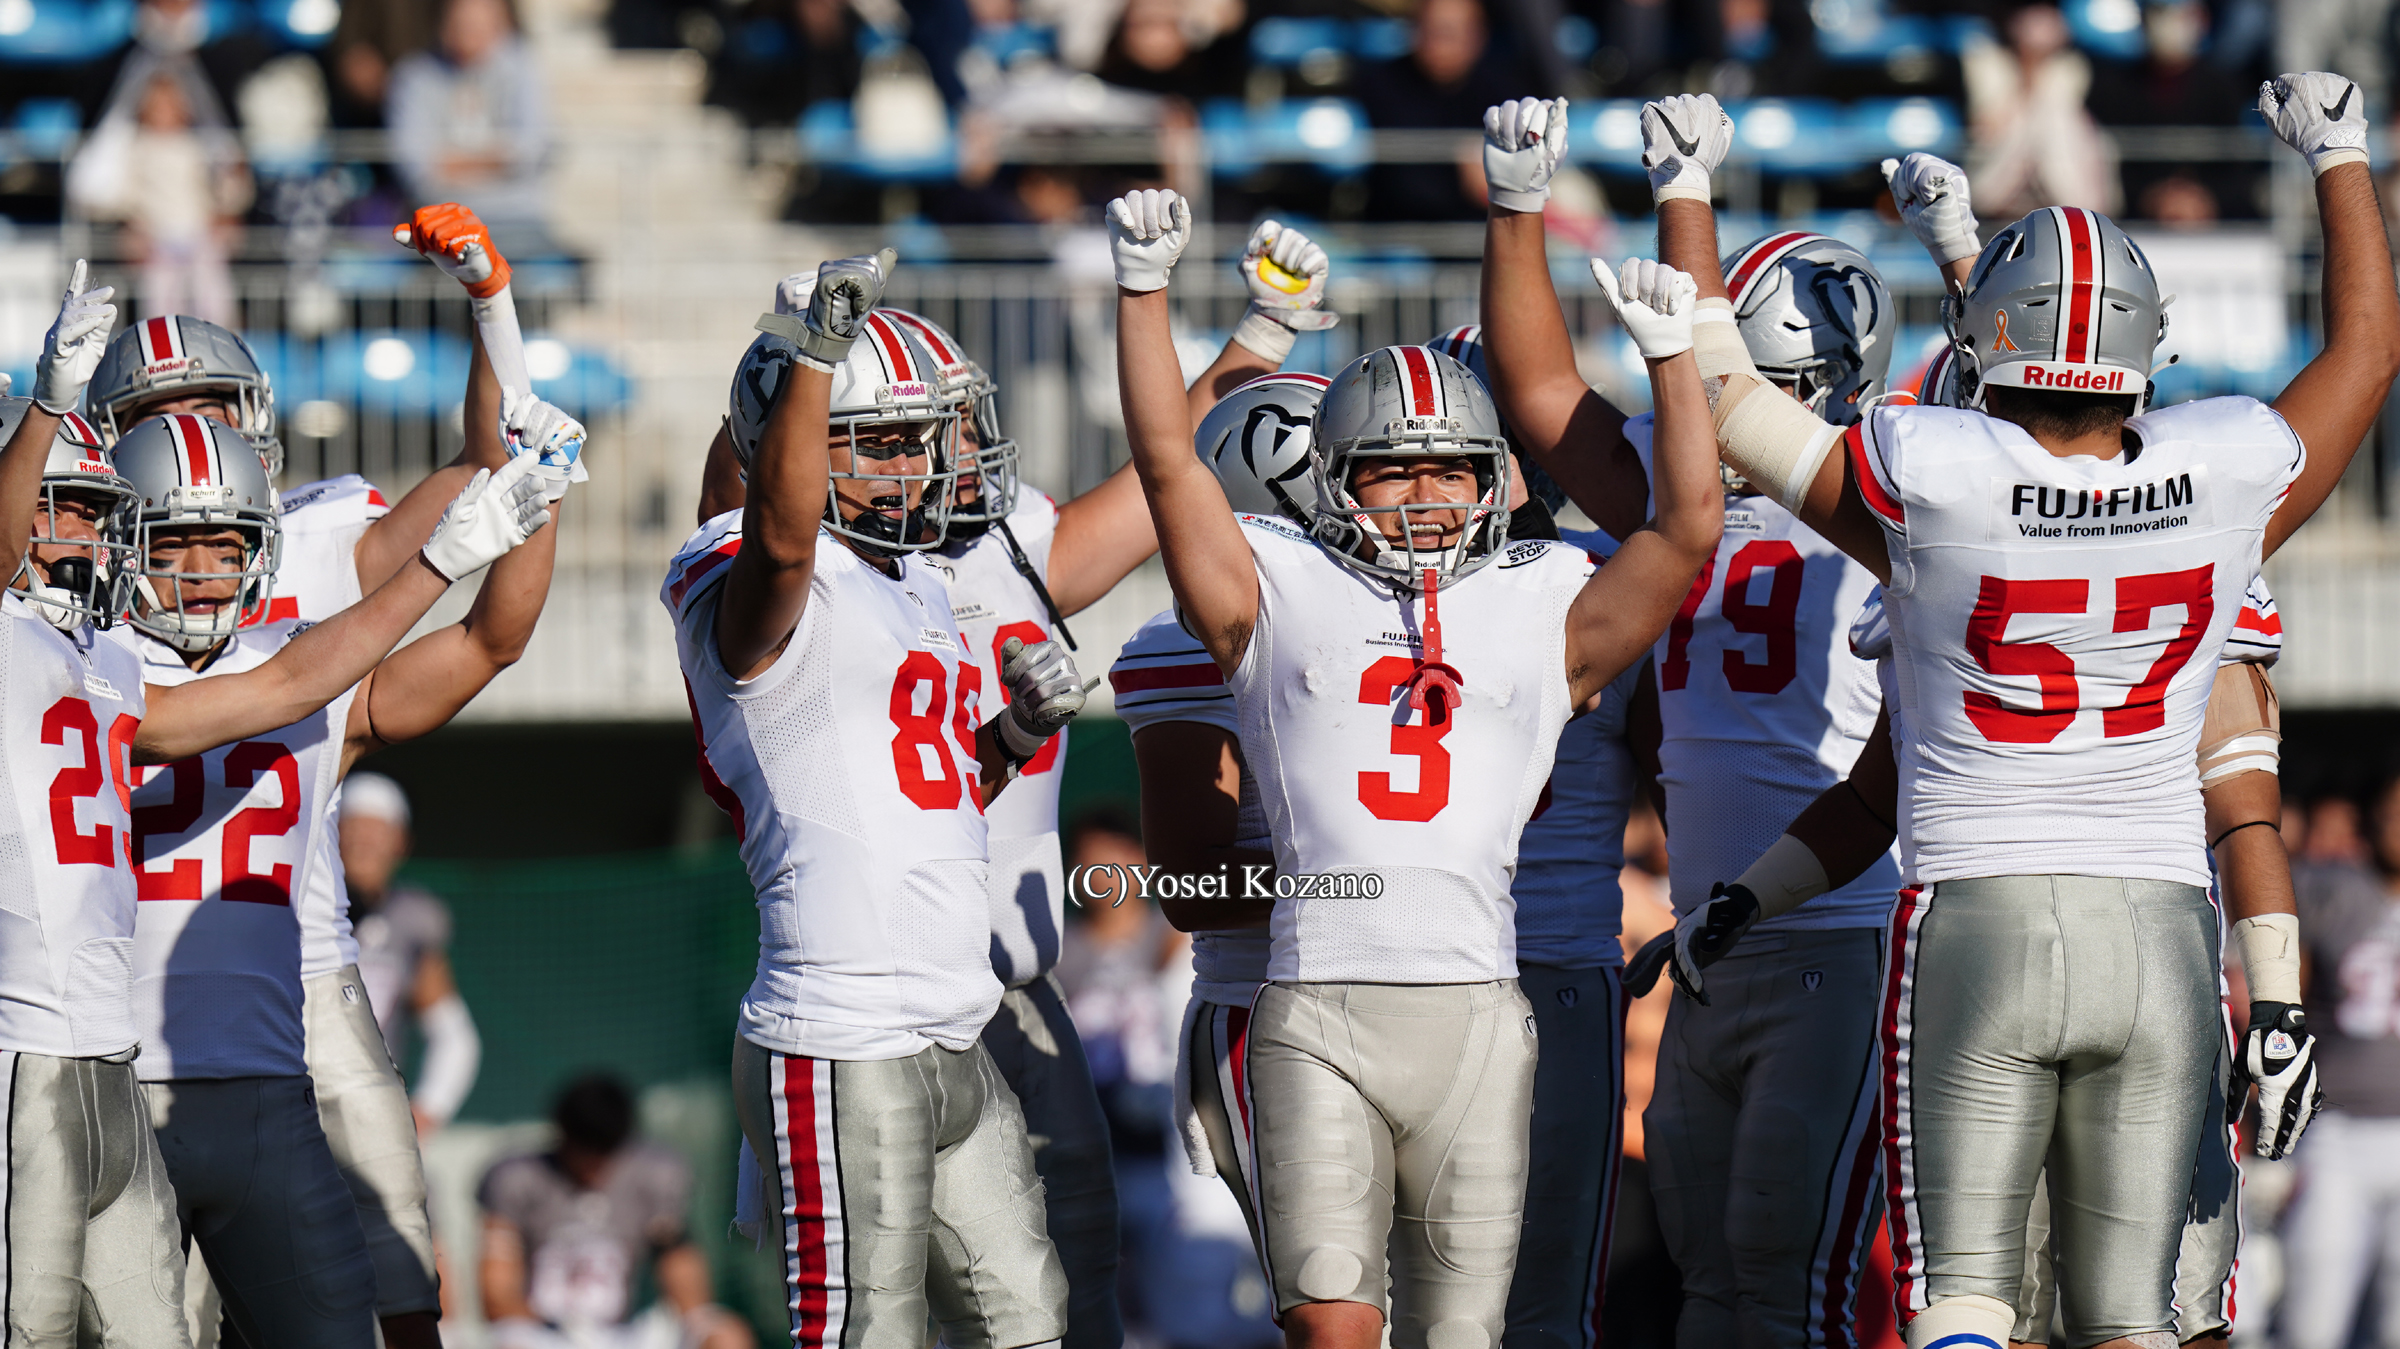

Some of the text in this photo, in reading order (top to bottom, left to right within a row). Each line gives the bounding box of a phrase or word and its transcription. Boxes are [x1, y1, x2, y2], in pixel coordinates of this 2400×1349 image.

[2024, 366, 2124, 391] Riddell
[892, 384, 926, 397] Riddell
[79, 461, 115, 476] Riddell
[2012, 473, 2193, 519] FUJIFILM
[2018, 515, 2188, 538] Value from Innovation
[1509, 544, 1545, 563] STOP
[1365, 638, 1424, 651] Business Innovatio
[1382, 632, 1424, 644] FUJIFIL
[1963, 562, 2214, 743] 57
[1358, 656, 1452, 822] 3
[131, 738, 301, 907] 22
